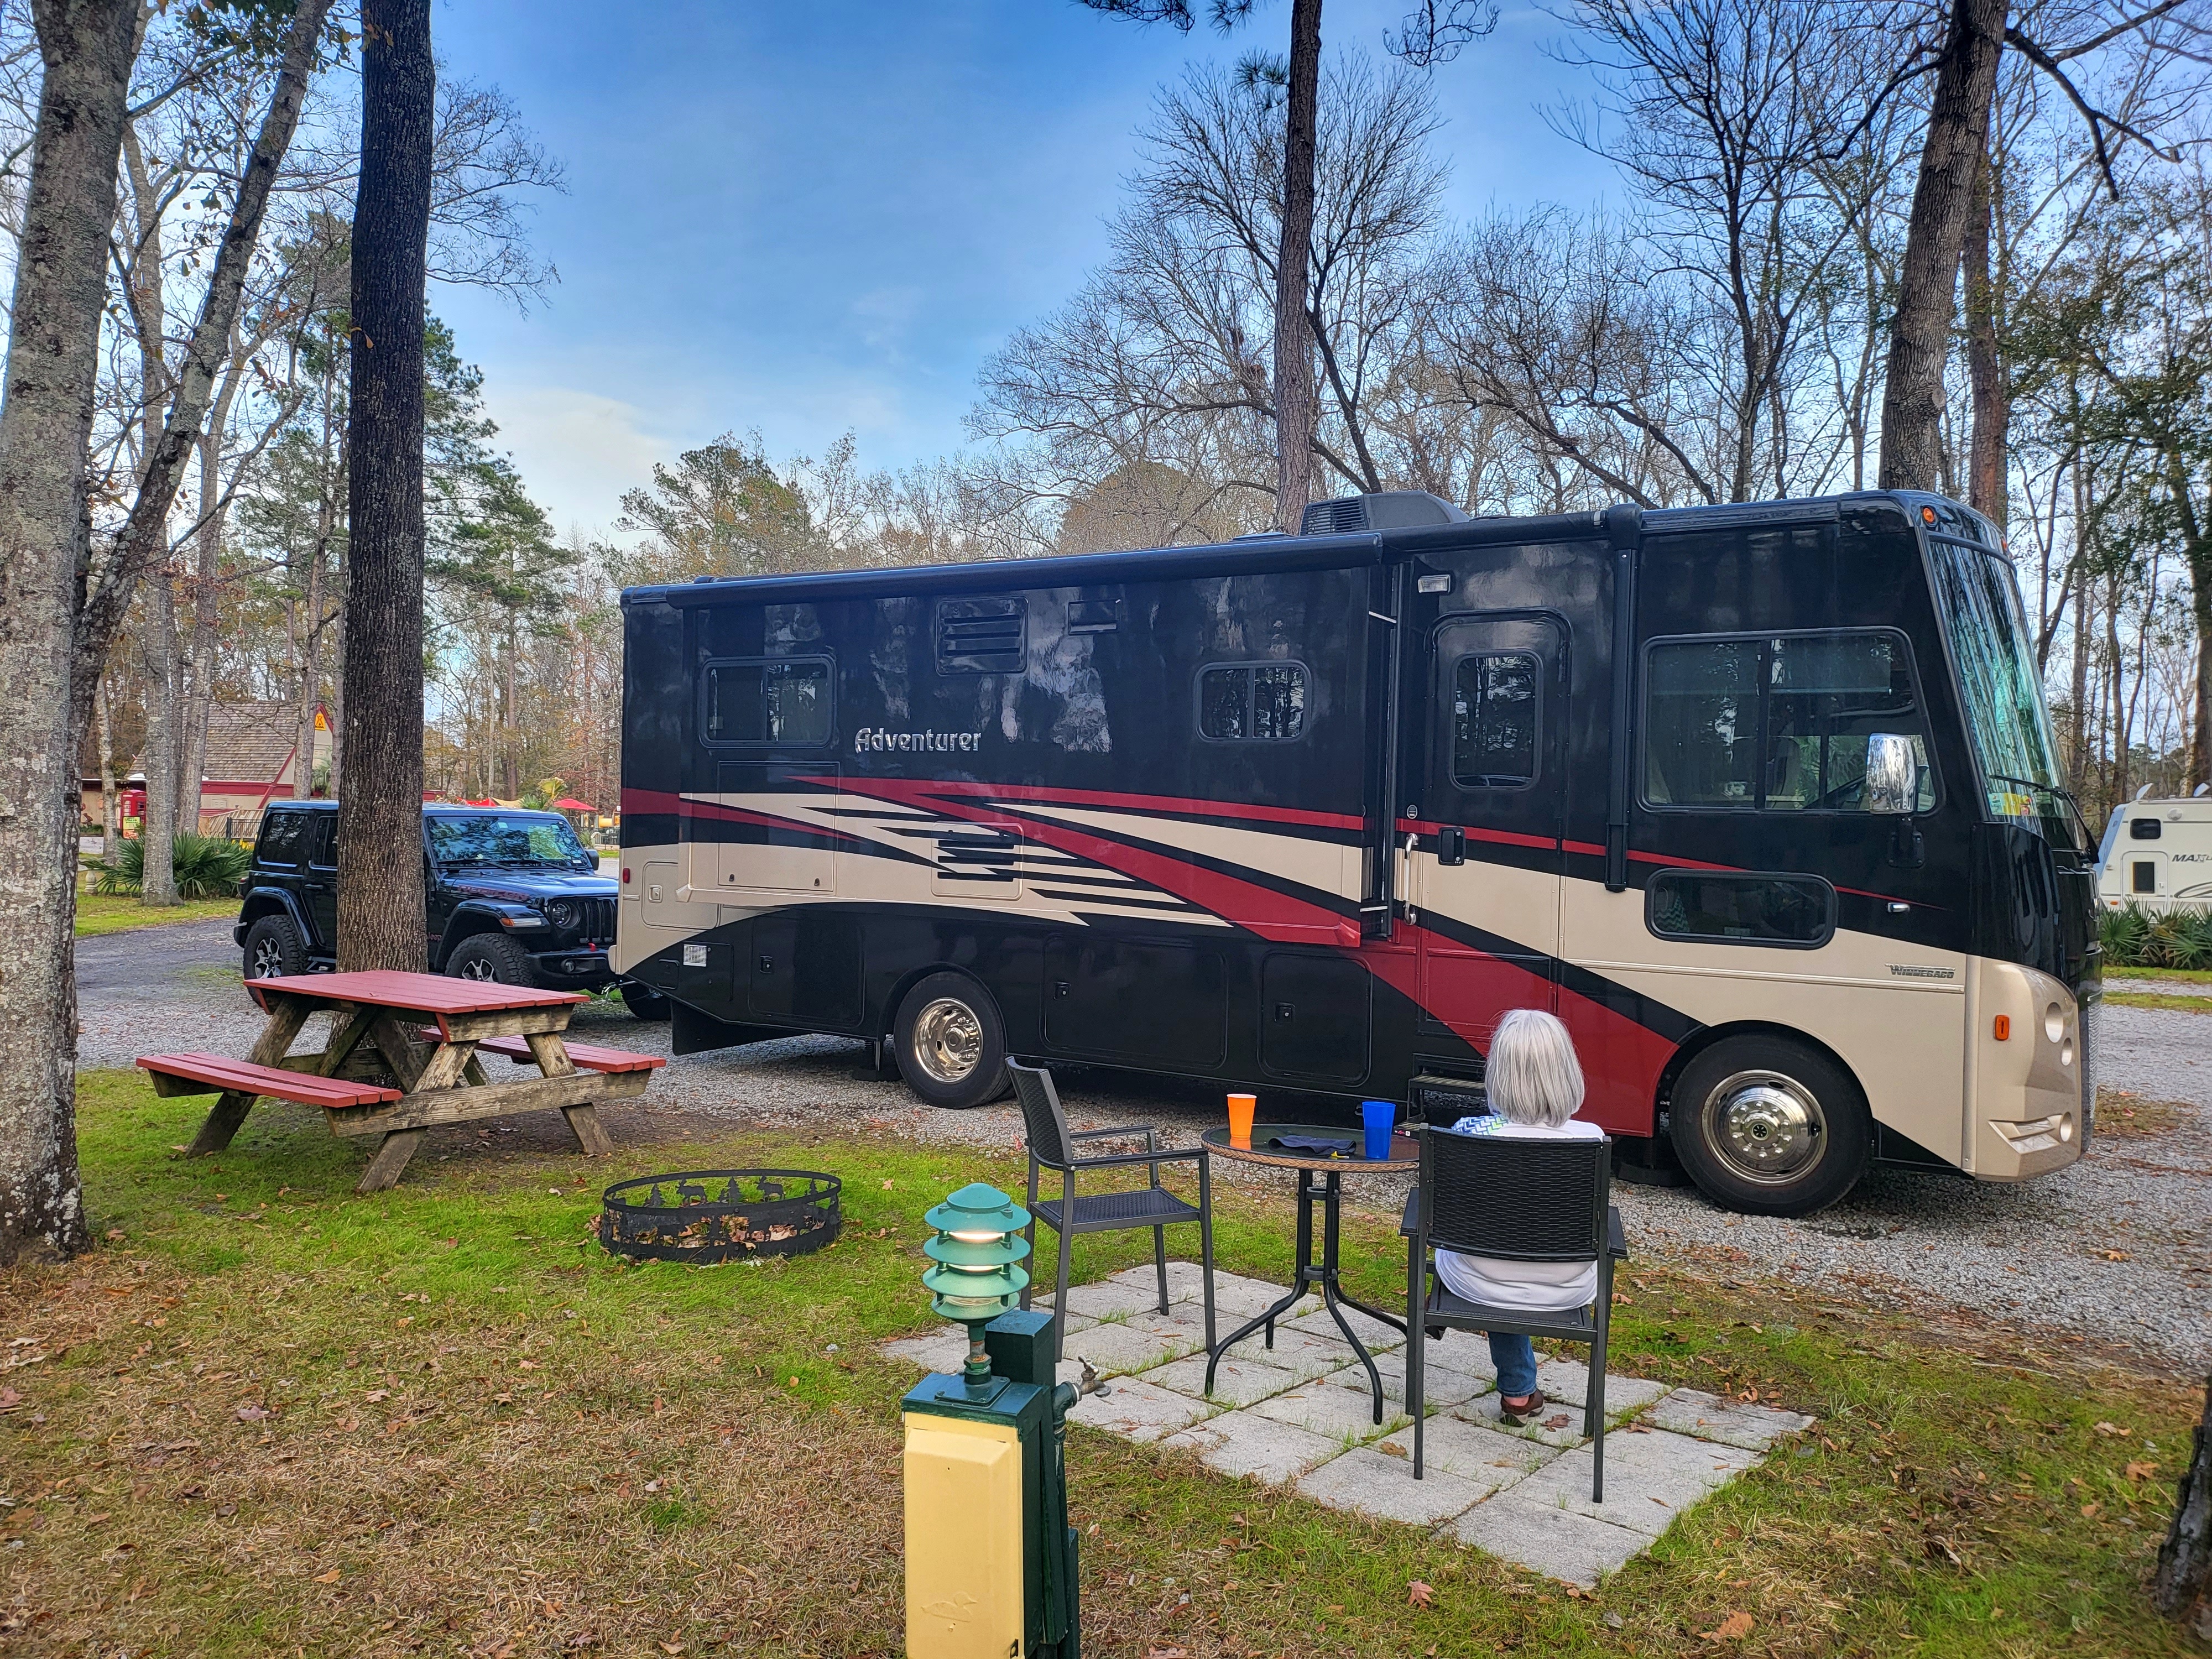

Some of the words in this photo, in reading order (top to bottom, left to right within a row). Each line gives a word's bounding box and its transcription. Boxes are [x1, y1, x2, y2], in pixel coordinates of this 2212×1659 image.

[854, 727, 982, 753] Adventurer
[427, 932, 442, 942] Jeep
[1885, 963, 1956, 979] WINNEBAGO
